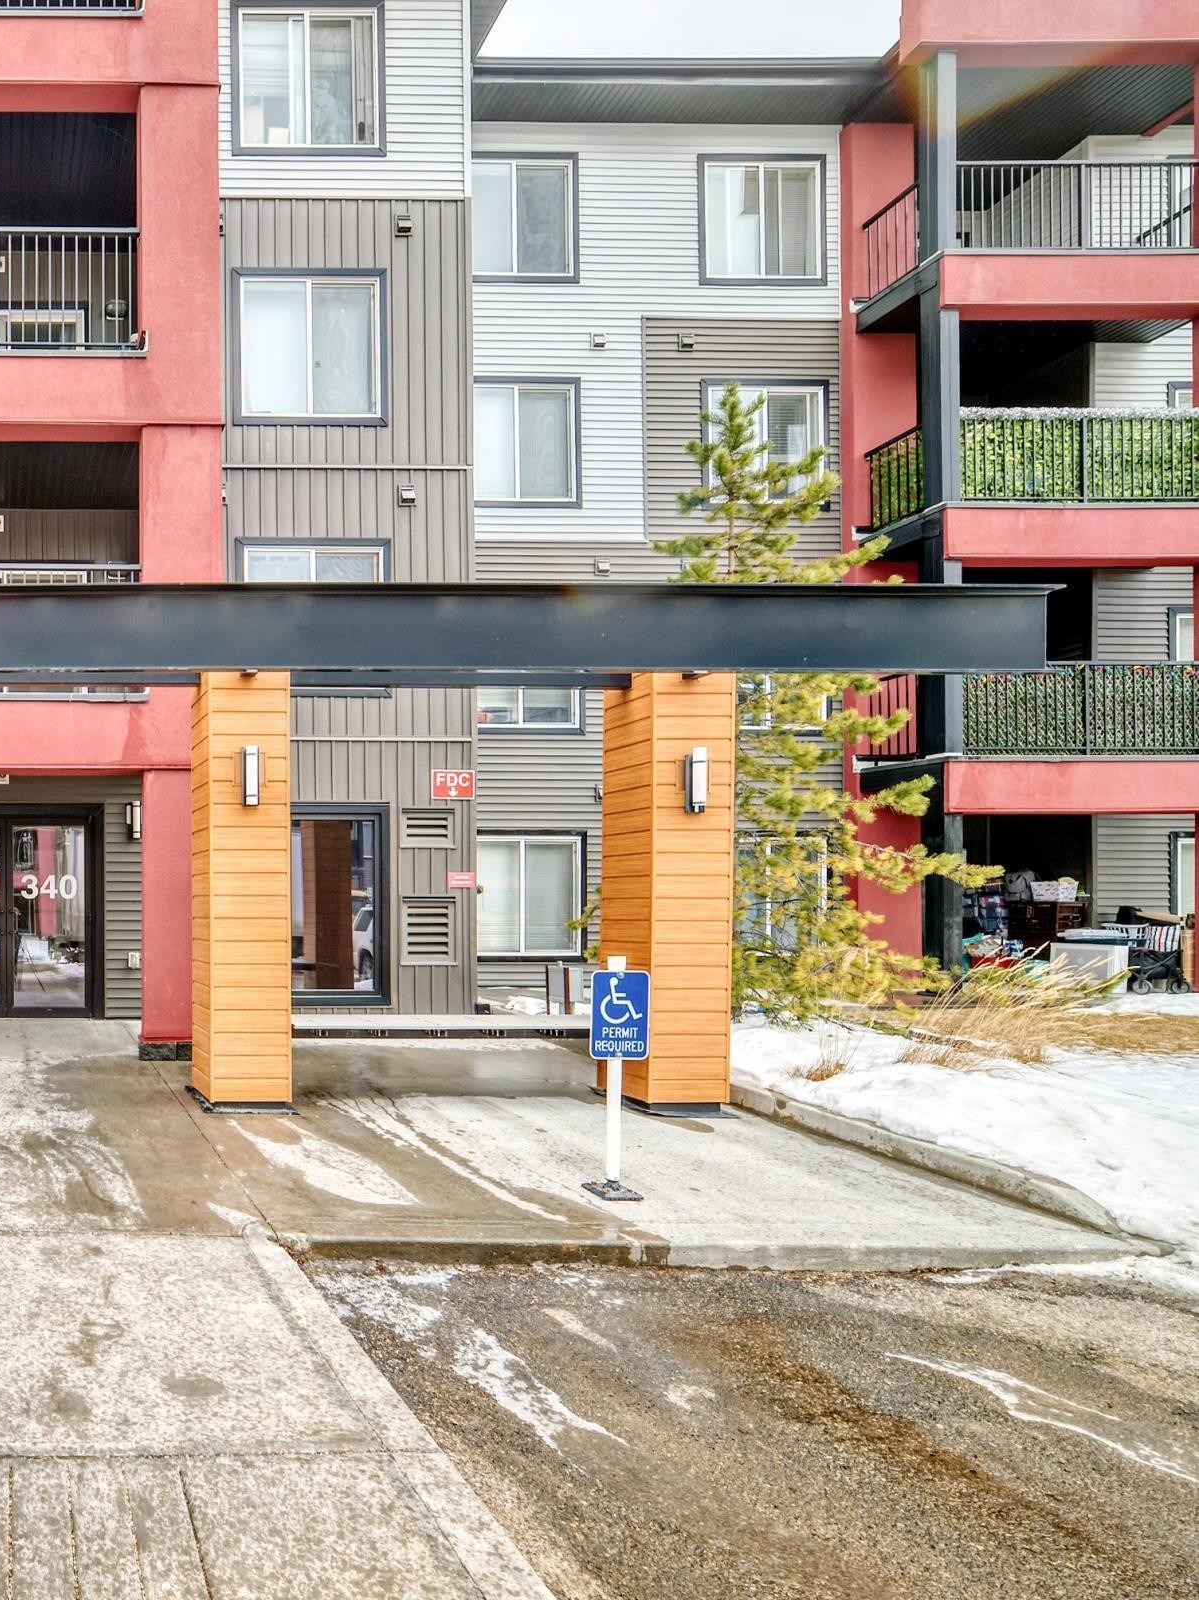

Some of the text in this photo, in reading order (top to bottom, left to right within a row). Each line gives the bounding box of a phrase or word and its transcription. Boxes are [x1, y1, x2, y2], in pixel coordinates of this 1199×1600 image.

[436, 772, 471, 787] FDC
[20, 874, 77, 899] 340
[602, 1026, 638, 1039] PERMIT
[594, 1040, 644, 1053] REQUIRED
